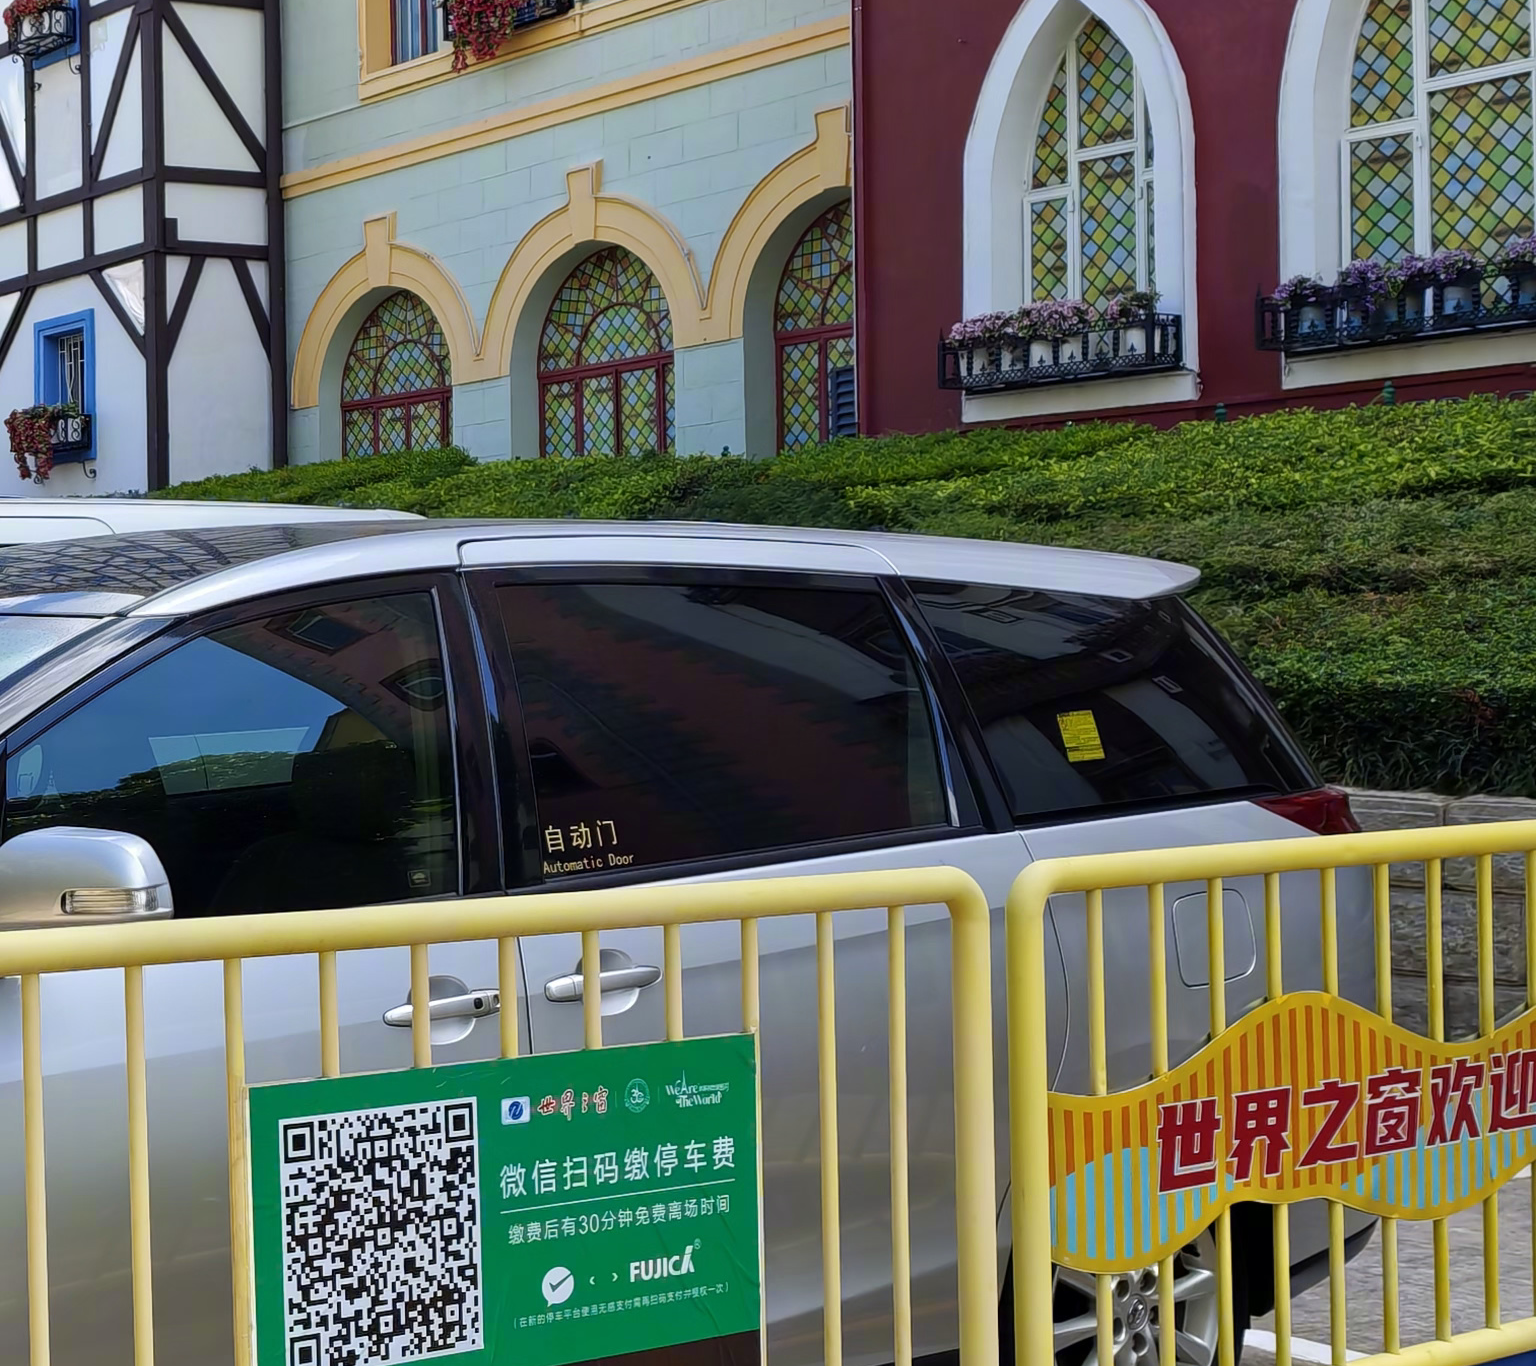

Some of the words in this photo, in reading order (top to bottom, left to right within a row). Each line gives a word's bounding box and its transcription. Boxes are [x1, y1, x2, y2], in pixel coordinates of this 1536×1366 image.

[544, 819, 618, 853] 自动门
[543, 855, 604, 875] Automatic
[608, 853, 634, 866] Door
[536, 1084, 609, 1122] 世界之窗
[1157, 1049, 1536, 1194] 世界之窗欢迎
[499, 1135, 735, 1199] 微信扫码缴停车费
[507, 1194, 731, 1246] 缴费后有30分钟免费离场时间
[629, 1244, 695, 1283] FUJICA
